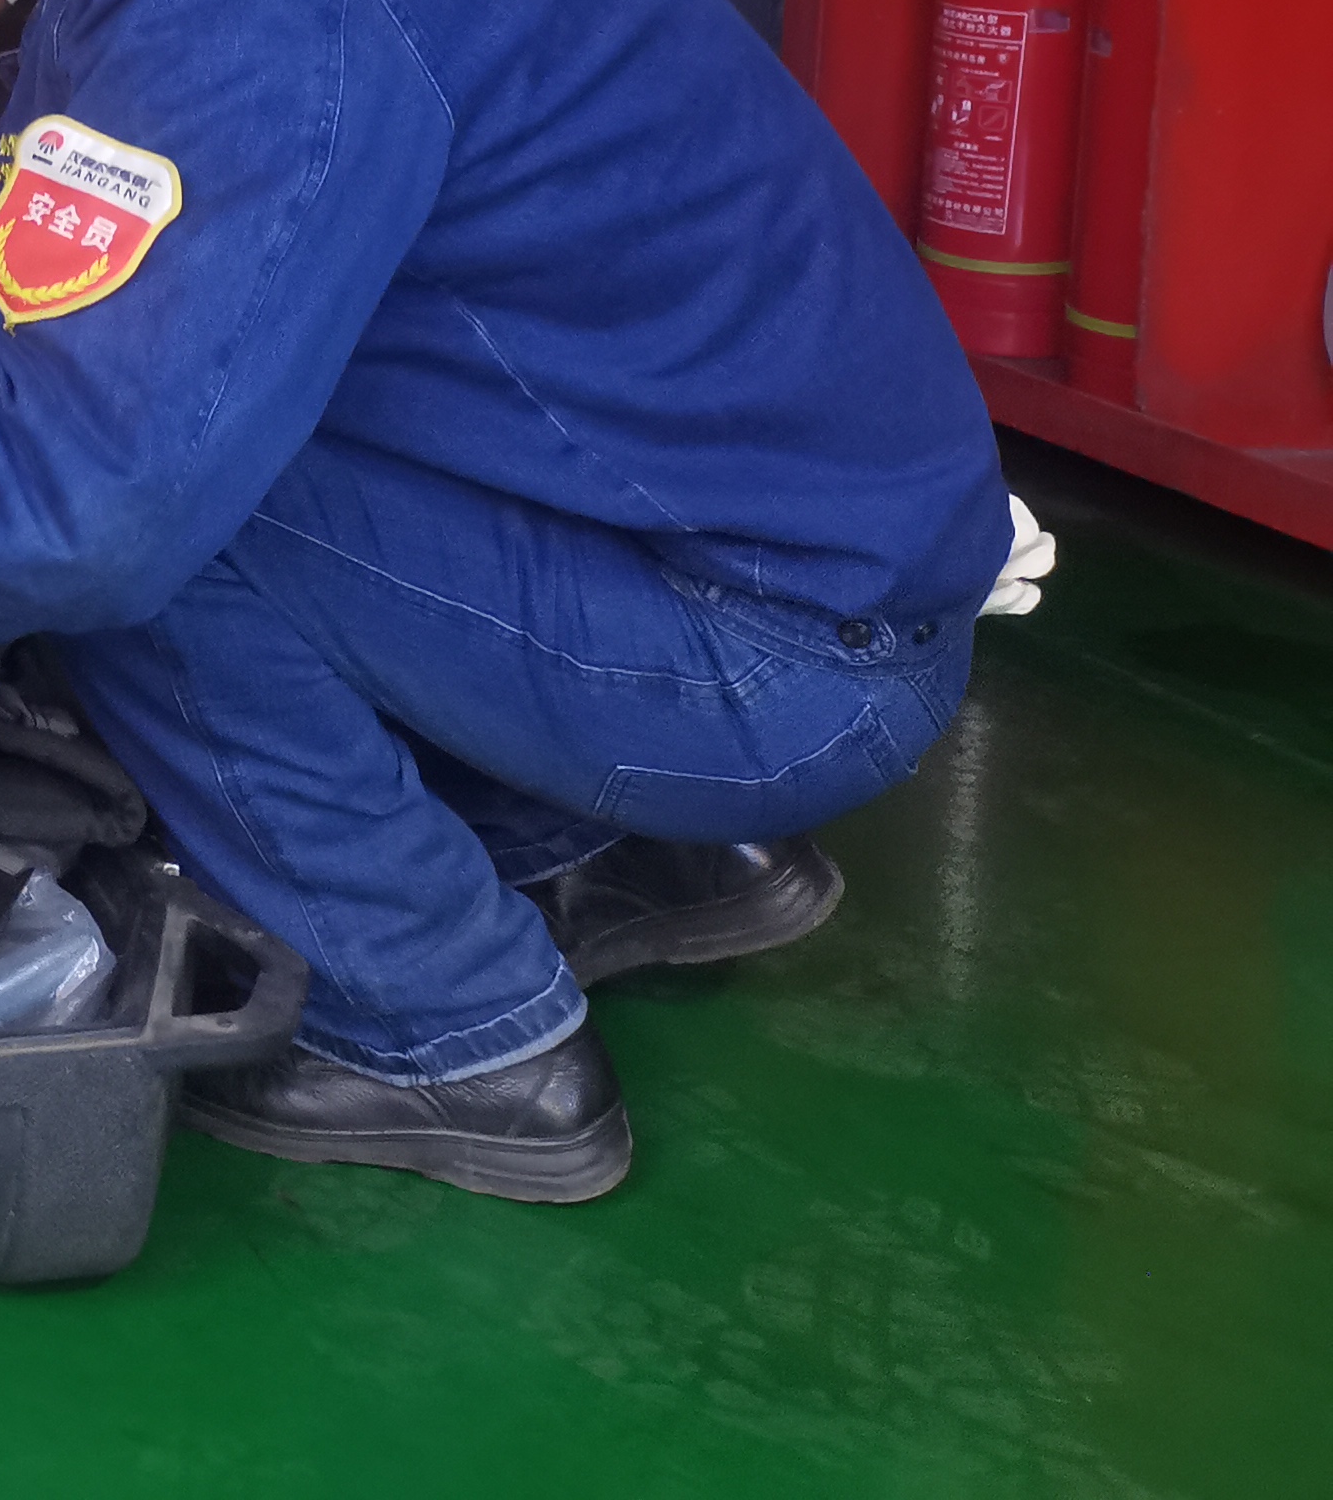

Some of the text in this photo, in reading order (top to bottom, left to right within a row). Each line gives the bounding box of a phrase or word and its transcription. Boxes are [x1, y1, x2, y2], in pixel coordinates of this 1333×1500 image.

[59, 161, 152, 210] HANGANG
[22, 192, 118, 253] 安全员
